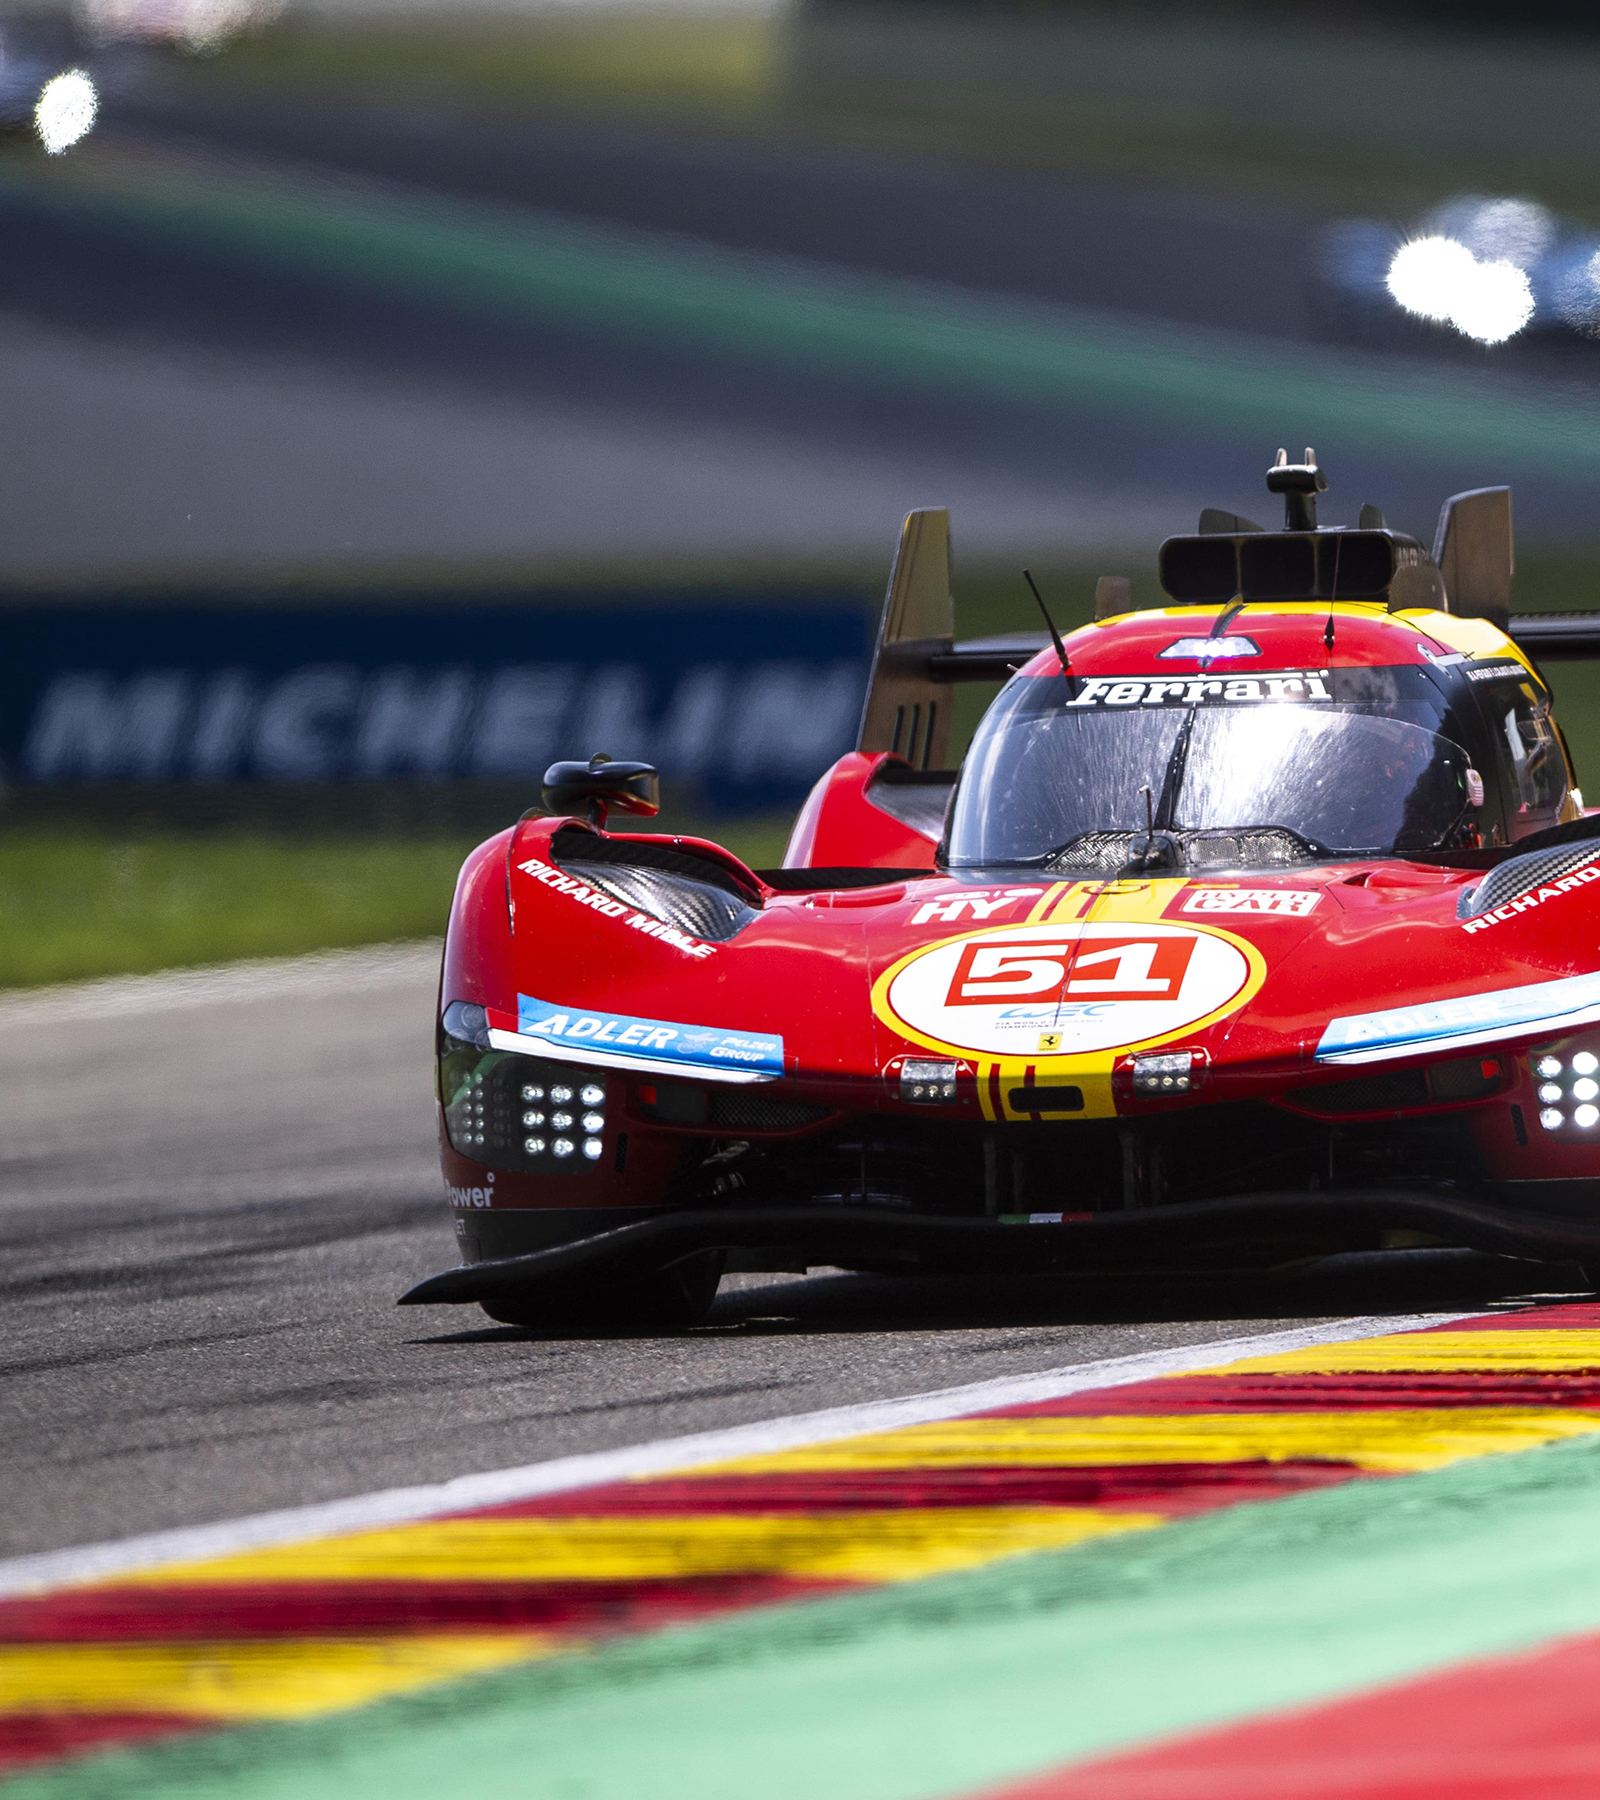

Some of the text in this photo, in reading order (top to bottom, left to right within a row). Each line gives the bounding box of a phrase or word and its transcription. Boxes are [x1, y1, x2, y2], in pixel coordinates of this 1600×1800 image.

[1066, 669, 1331, 706] Ferrari
[28, 662, 858, 778] MICHELIN
[517, 859, 628, 917] RICHARD
[1194, 898, 1303, 912] CAR
[911, 897, 1017, 925] HY
[961, 943, 1171, 997] 51
[999, 1004, 1116, 1018] WEC
[1345, 1001, 1502, 1044] ADLER
[525, 1013, 678, 1049] ADLER
[721, 1036, 776, 1052] PELZER
[709, 1046, 765, 1062] GROUP
